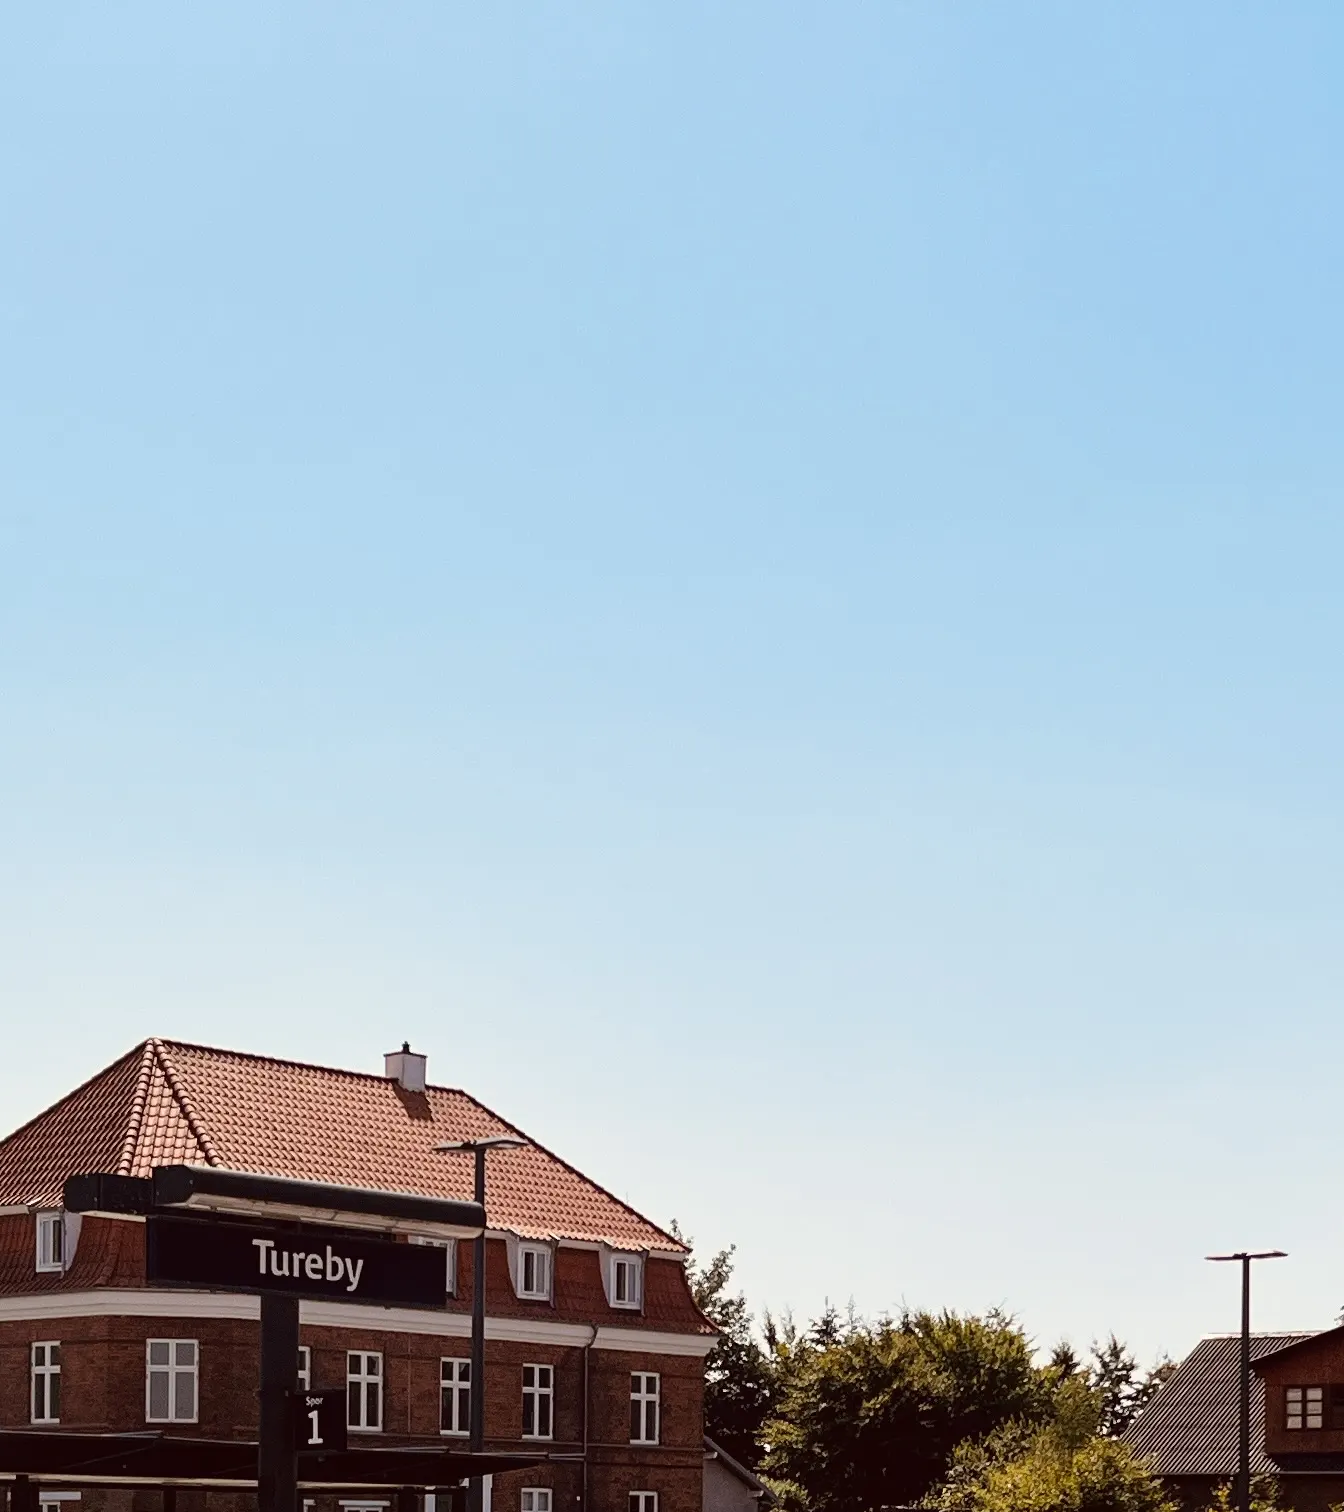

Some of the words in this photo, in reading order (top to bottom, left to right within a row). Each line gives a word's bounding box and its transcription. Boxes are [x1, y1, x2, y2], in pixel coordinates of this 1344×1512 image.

[252, 1238, 364, 1292] Tureby
[306, 1396, 324, 1407] Spor
[308, 1410, 323, 1444] 1
